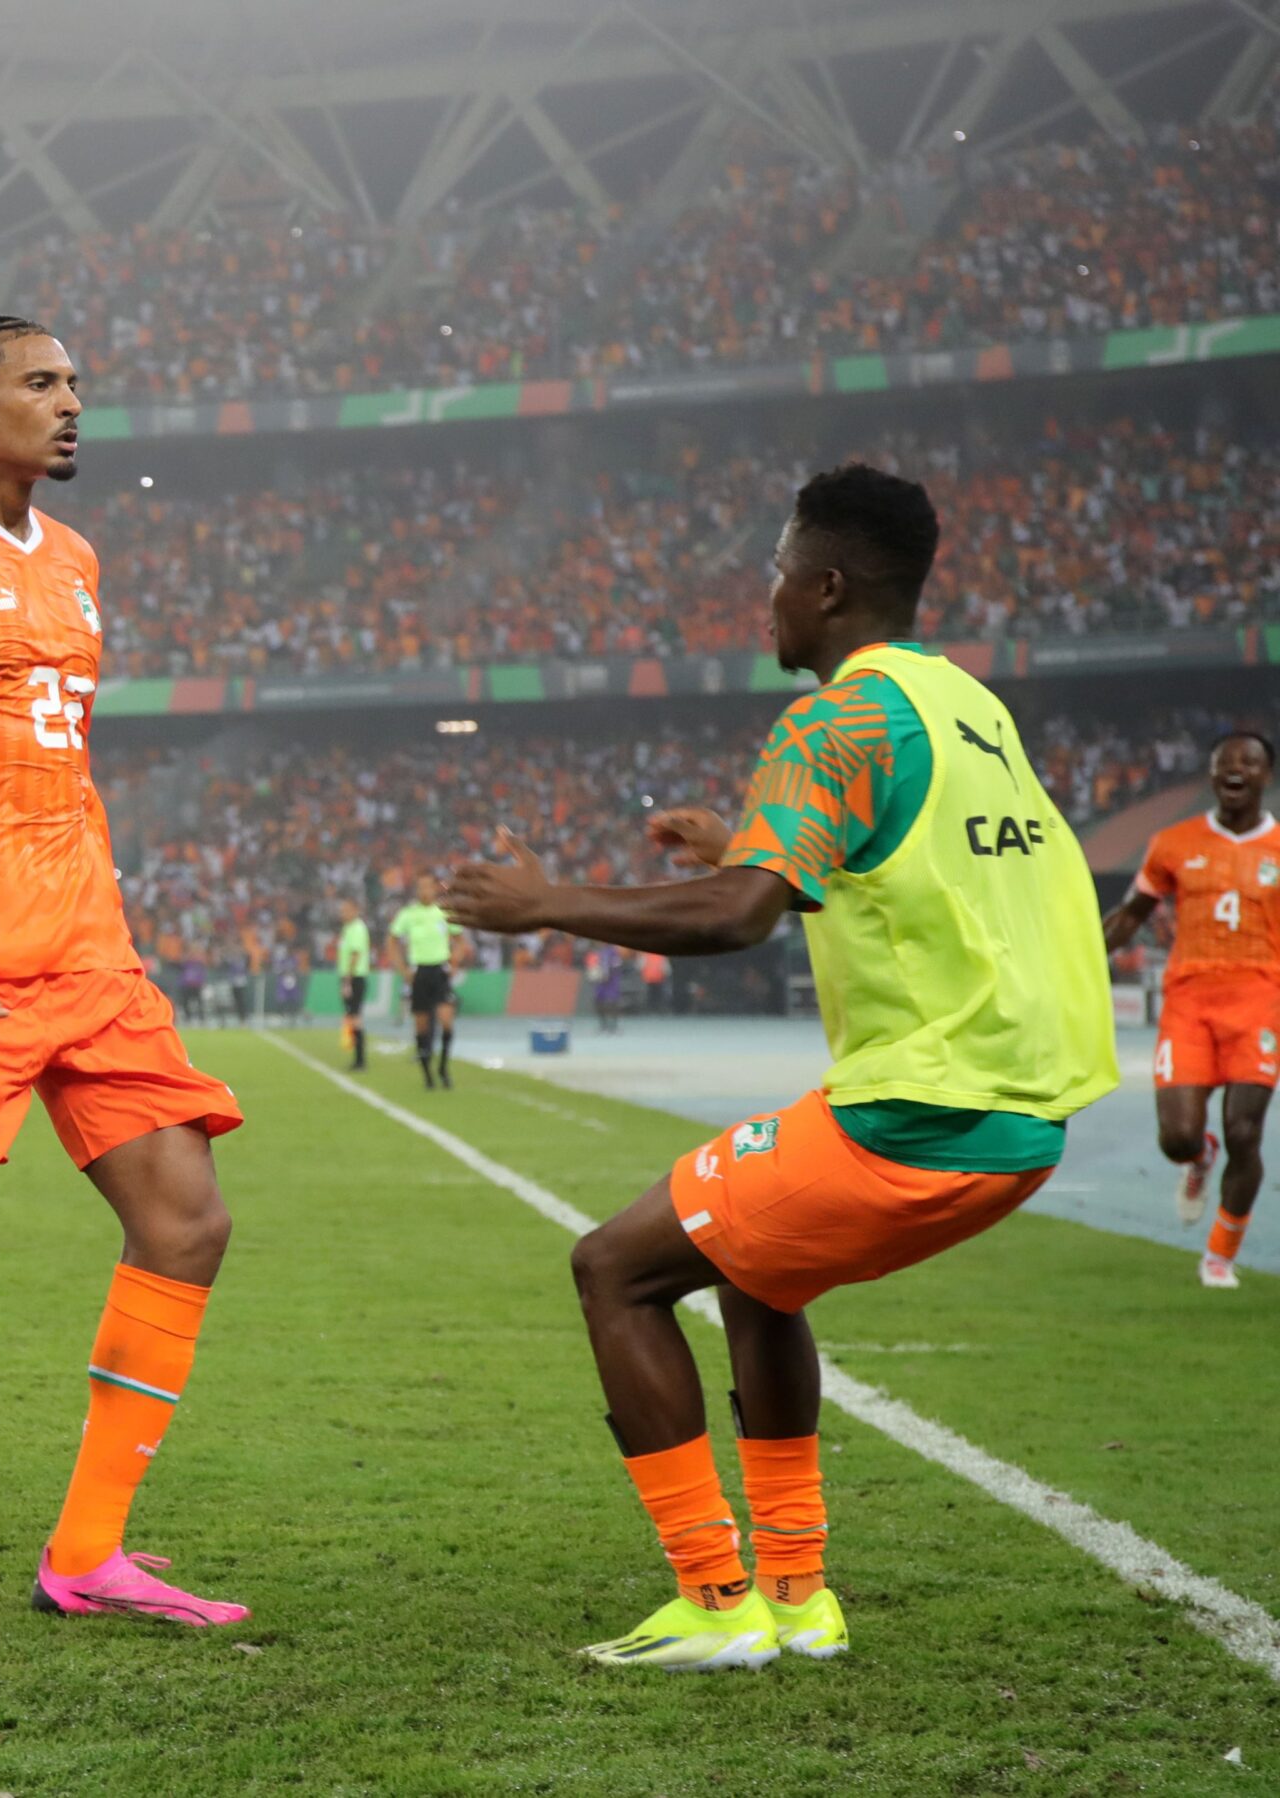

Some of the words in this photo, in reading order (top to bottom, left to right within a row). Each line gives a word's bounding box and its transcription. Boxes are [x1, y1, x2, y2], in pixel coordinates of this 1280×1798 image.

[966, 815, 1045, 857] CAF
[1214, 890, 1240, 932] 4
[1155, 1040, 1173, 1082] 4
